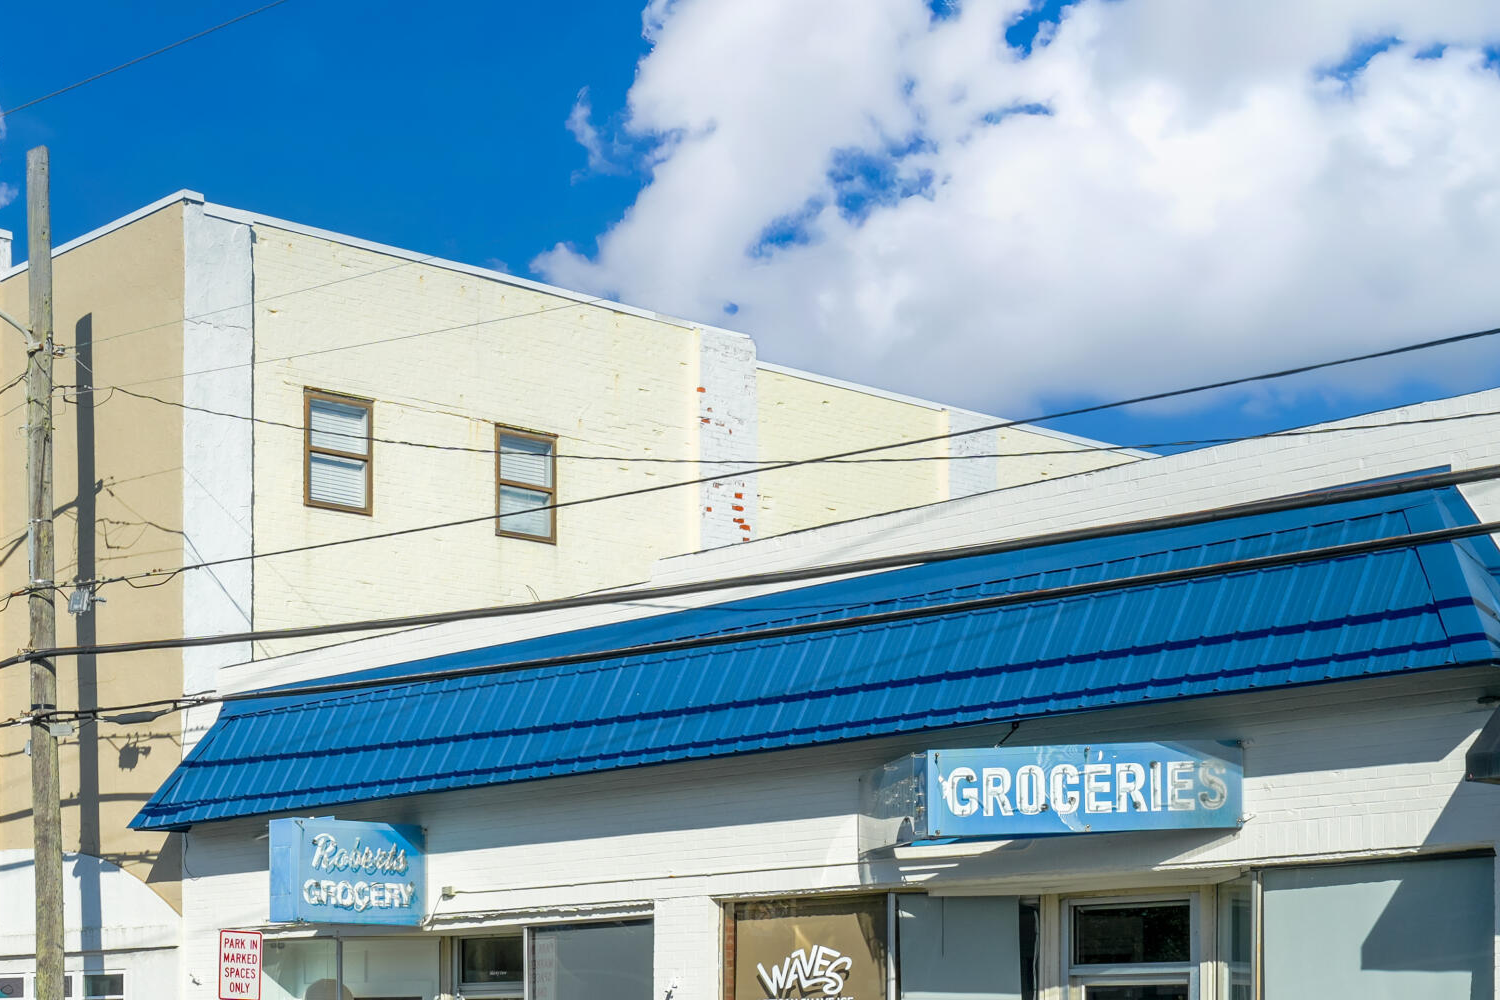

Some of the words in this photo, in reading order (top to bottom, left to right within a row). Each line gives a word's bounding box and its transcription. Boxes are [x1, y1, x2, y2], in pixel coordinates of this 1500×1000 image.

[950, 760, 1228, 817] GROCERIES
[311, 833, 408, 873] Roberts
[303, 879, 415, 911] GROCERY
[224, 938, 246, 949] PARK
[250, 939, 257, 949] IN
[224, 953, 257, 964] MARKED
[225, 967, 256, 979] SPACES
[757, 945, 852, 996] WAVES
[230, 982, 250, 993] ONLY
